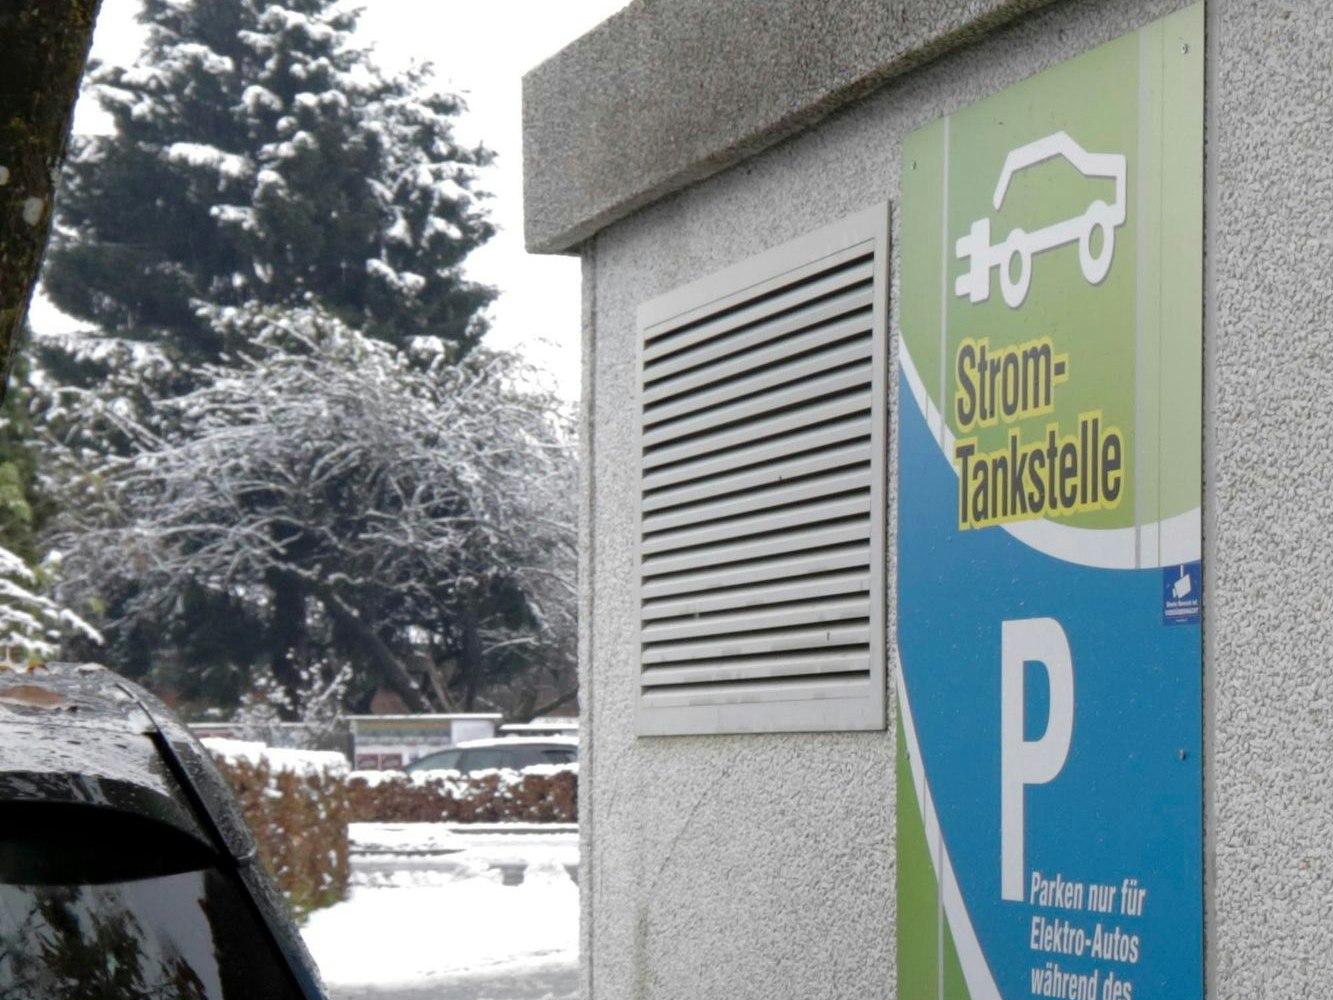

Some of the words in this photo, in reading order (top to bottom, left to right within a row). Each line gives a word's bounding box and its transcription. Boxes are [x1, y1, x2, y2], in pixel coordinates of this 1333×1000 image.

[957, 343, 1066, 426] Strom-
[956, 418, 1122, 523] Tankstelle
[1001, 617, 1074, 902] P
[1030, 871, 1083, 910] Parken
[1088, 884, 1116, 913] nur
[1121, 878, 1147, 916] für
[1030, 916, 1139, 964] Elektro-Autos
